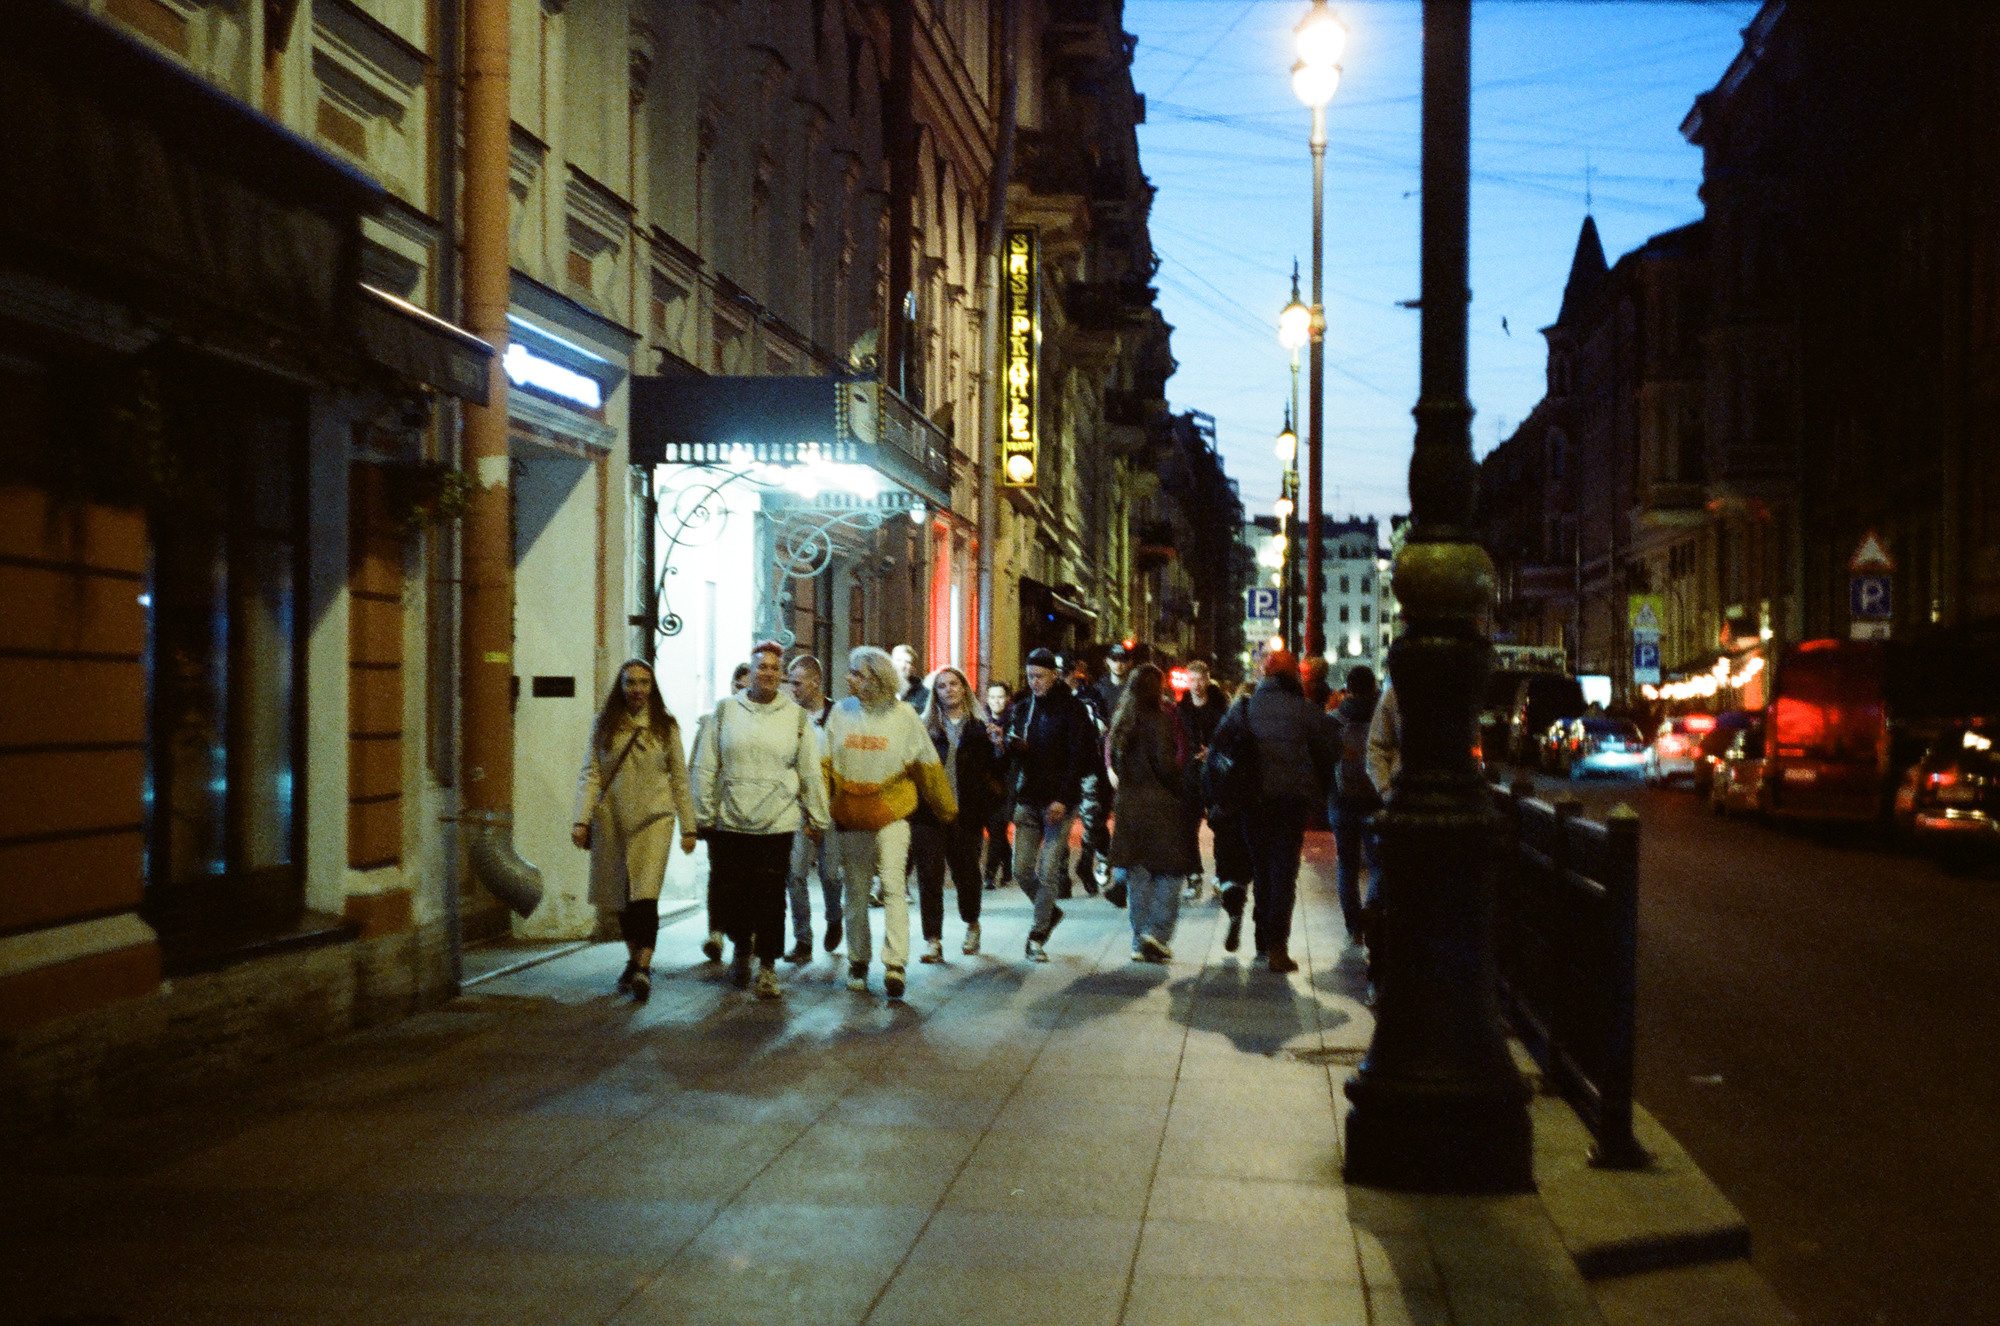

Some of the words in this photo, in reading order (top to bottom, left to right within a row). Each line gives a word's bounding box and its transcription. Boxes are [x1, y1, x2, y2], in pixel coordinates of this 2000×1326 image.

[1255, 590, 1273, 616] P
[1862, 579, 1883, 610] P
[1641, 645, 1655, 667] P
